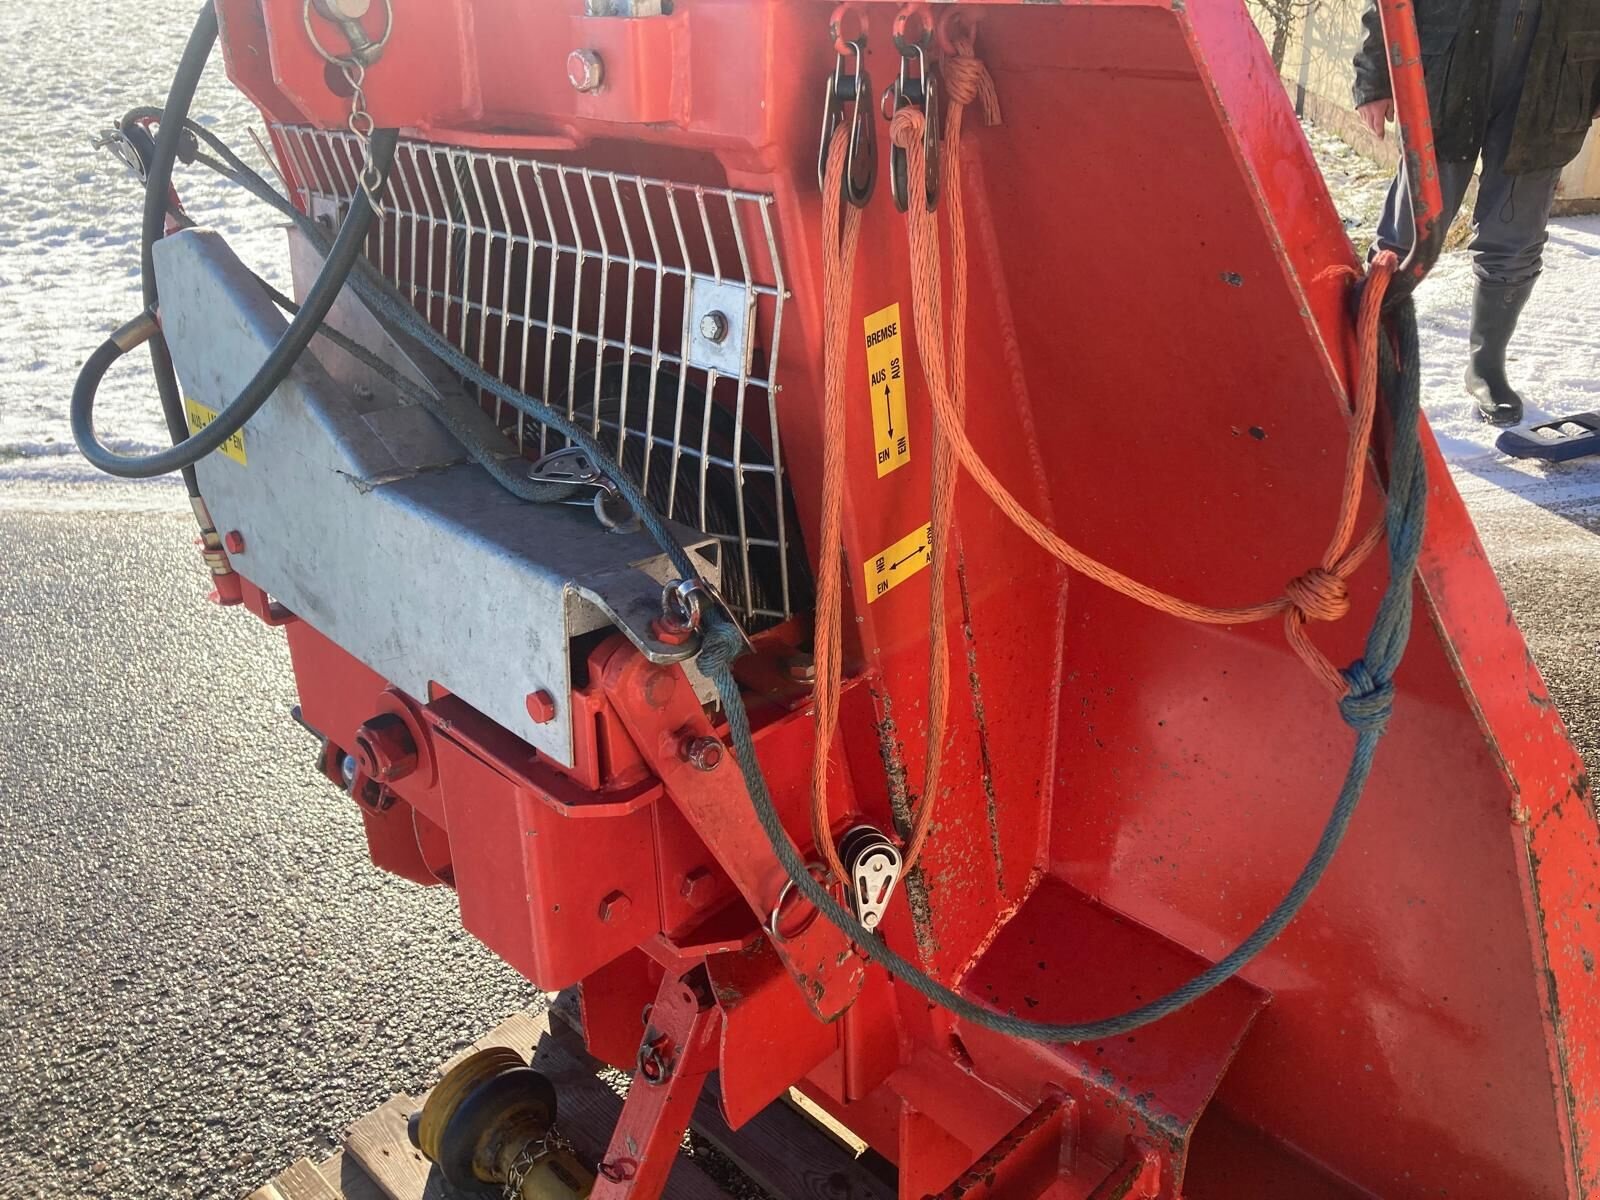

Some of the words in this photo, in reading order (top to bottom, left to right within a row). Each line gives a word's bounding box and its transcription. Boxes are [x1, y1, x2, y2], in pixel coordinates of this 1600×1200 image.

[866, 322, 898, 348] BREMSE
[871, 368, 887, 387] AUS
[891, 357, 900, 380] AUS
[878, 447, 890, 464] EIN
[897, 436, 907, 456] EIN
[876, 556, 885, 574] EIN
[877, 579, 889, 595] EIN
